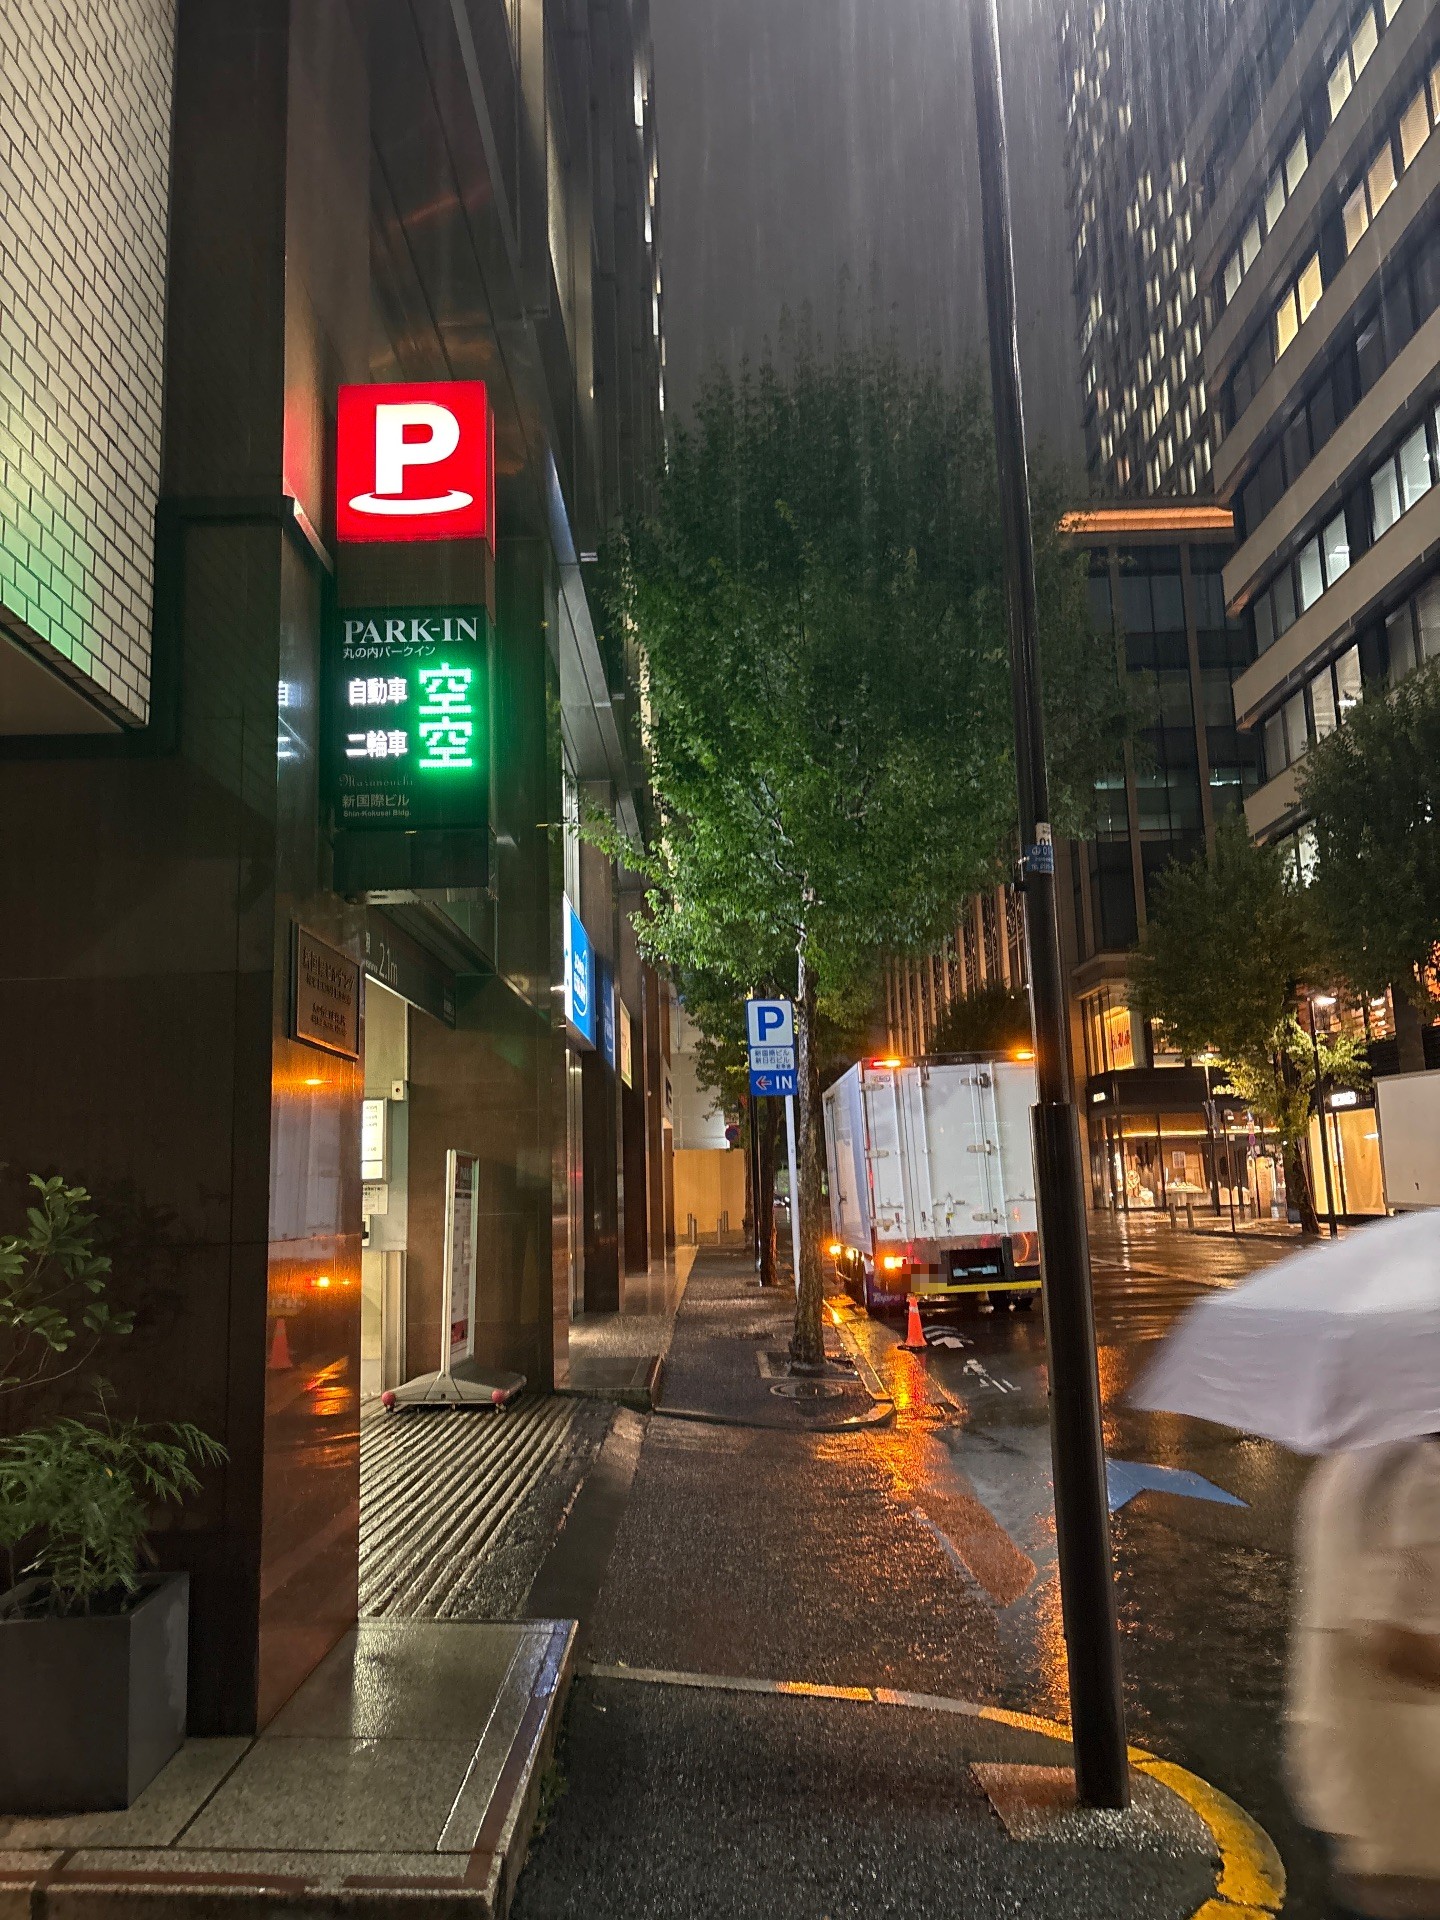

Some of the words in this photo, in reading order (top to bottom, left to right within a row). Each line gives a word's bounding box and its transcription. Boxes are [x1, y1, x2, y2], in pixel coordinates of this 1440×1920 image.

[375, 403, 460, 494] P
[344, 618, 479, 644] PARK-IN
[343, 646, 436, 659] 丸の内パークイン
[348, 677, 408, 706] 自動車
[418, 662, 473, 715] 空
[346, 730, 408, 759] 二輪車
[418, 716, 473, 769] 空
[342, 794, 410, 808] 新国際ビル
[757, 1006, 785, 1041] P
[775, 1075, 793, 1090] IN
